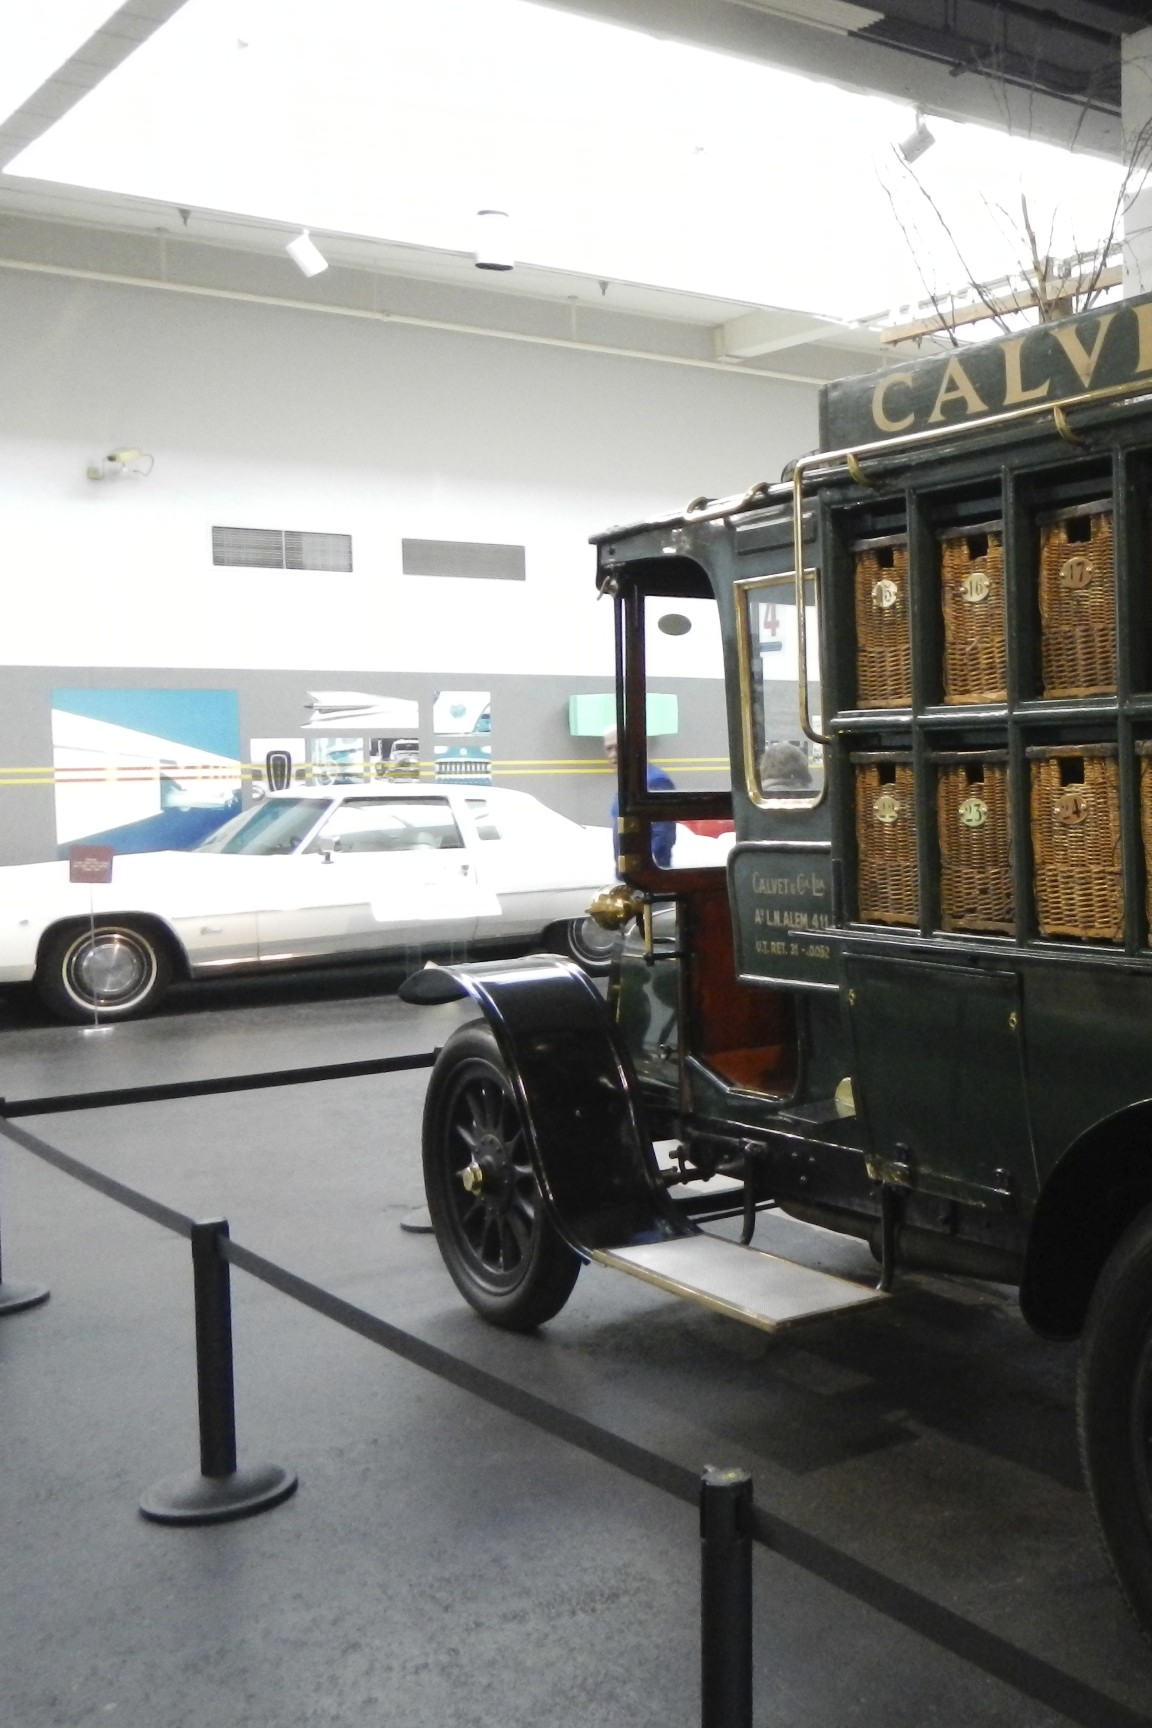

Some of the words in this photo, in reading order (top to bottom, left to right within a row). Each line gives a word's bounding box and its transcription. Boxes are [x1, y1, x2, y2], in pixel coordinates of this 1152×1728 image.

[1069, 561, 1086, 583] 17
[969, 580, 984, 597] 16
[964, 803, 982, 823] 23
[752, 872, 789, 895] CALVET
